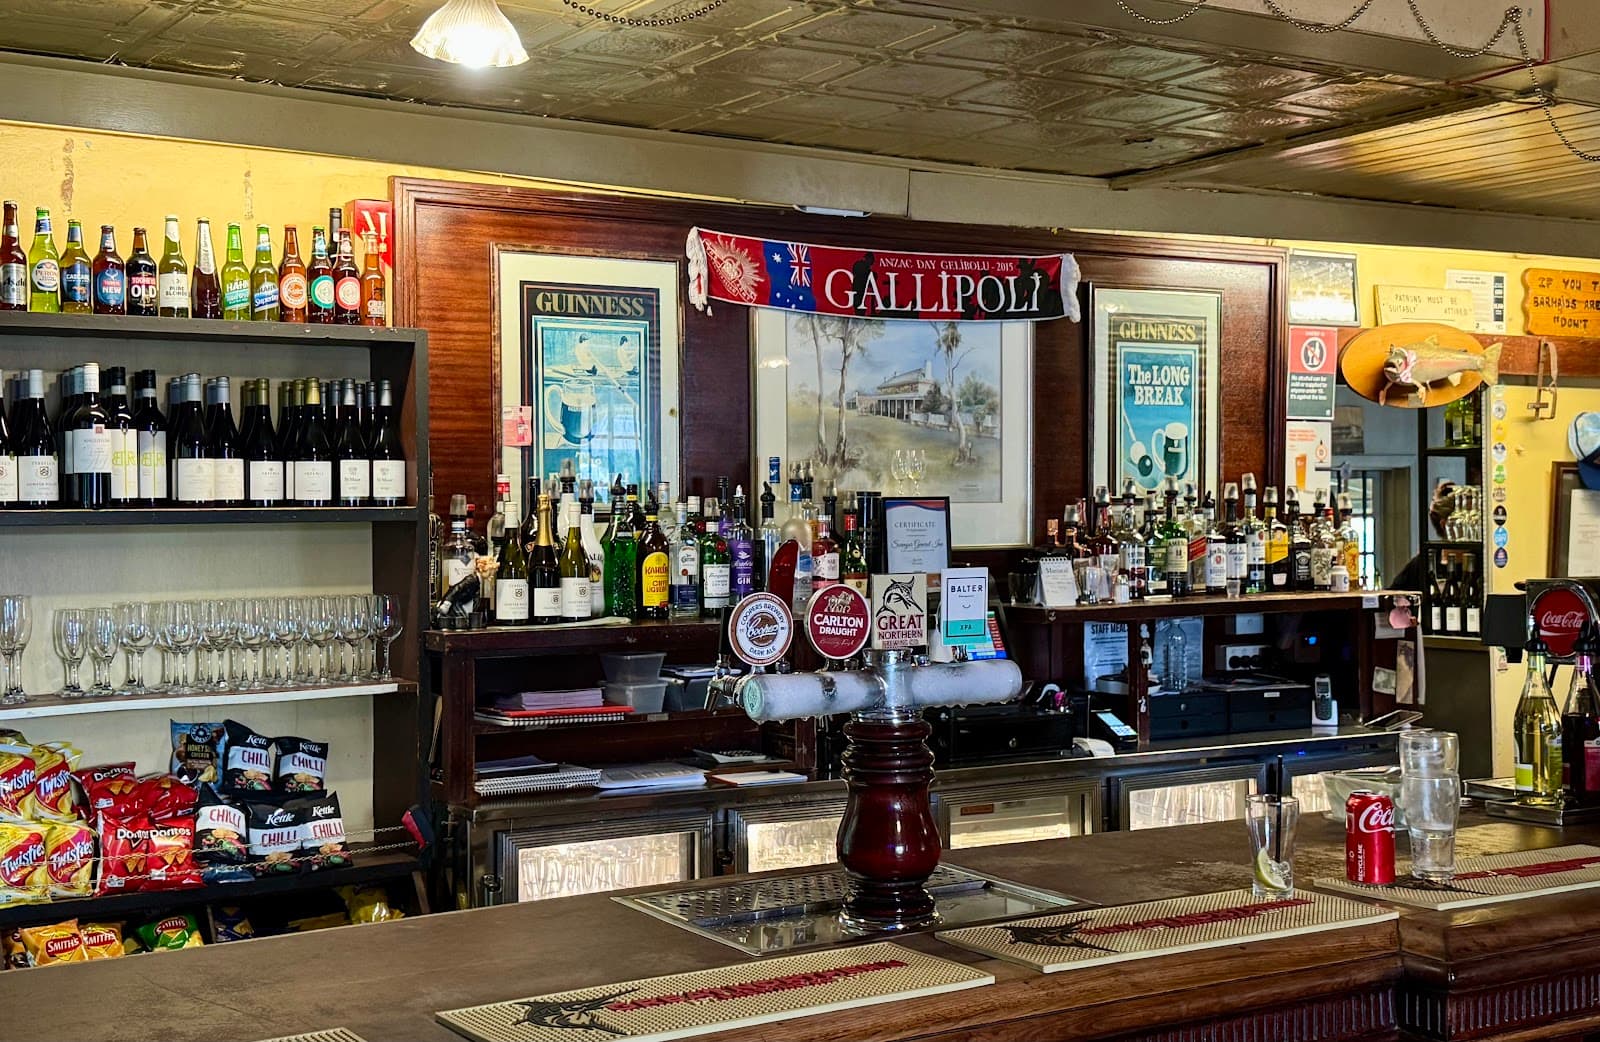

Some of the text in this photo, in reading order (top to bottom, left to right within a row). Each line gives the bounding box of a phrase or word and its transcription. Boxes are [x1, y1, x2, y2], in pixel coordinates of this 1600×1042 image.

[878, 257, 914, 270] ANZAC
[915, 259, 937, 271] DAY
[996, 262, 1015, 273] 2015
[102, 287, 122, 295] NEW
[1538, 276, 1553, 289] IF
[1562, 278, 1582, 291] YOU
[131, 285, 157, 298] OLD
[535, 291, 646, 317] GUINNESS
[1427, 296, 1443, 305] MUST
[1533, 296, 1578, 310] BARMAIDS
[1118, 321, 1197, 342] GUINNESS
[1127, 363, 1190, 387] The LONG
[1134, 386, 1185, 407] BREAK
[950, 584, 984, 593] BALTER
[741, 602, 786, 627] COOPERS BREWERY
[813, 613, 864, 628] CARLTON
[877, 614, 925, 631] GREAT
[1091, 623, 1109, 635] STAFF
[819, 627, 858, 637] DRAUGHT
[877, 630, 923, 640] NORTHERN
[749, 645, 776, 657] DARK ALE
[299, 742, 322, 754] Kettle
[291, 754, 323, 773] CHILLI
[209, 808, 242, 829] CHILLI
[312, 804, 335, 818] Kettle
[265, 811, 296, 827] Kettle
[149, 827, 192, 839] Doritos
[312, 821, 344, 840] CHILLI
[261, 829, 298, 848] CHILLI
[51, 840, 94, 872] Twisties
